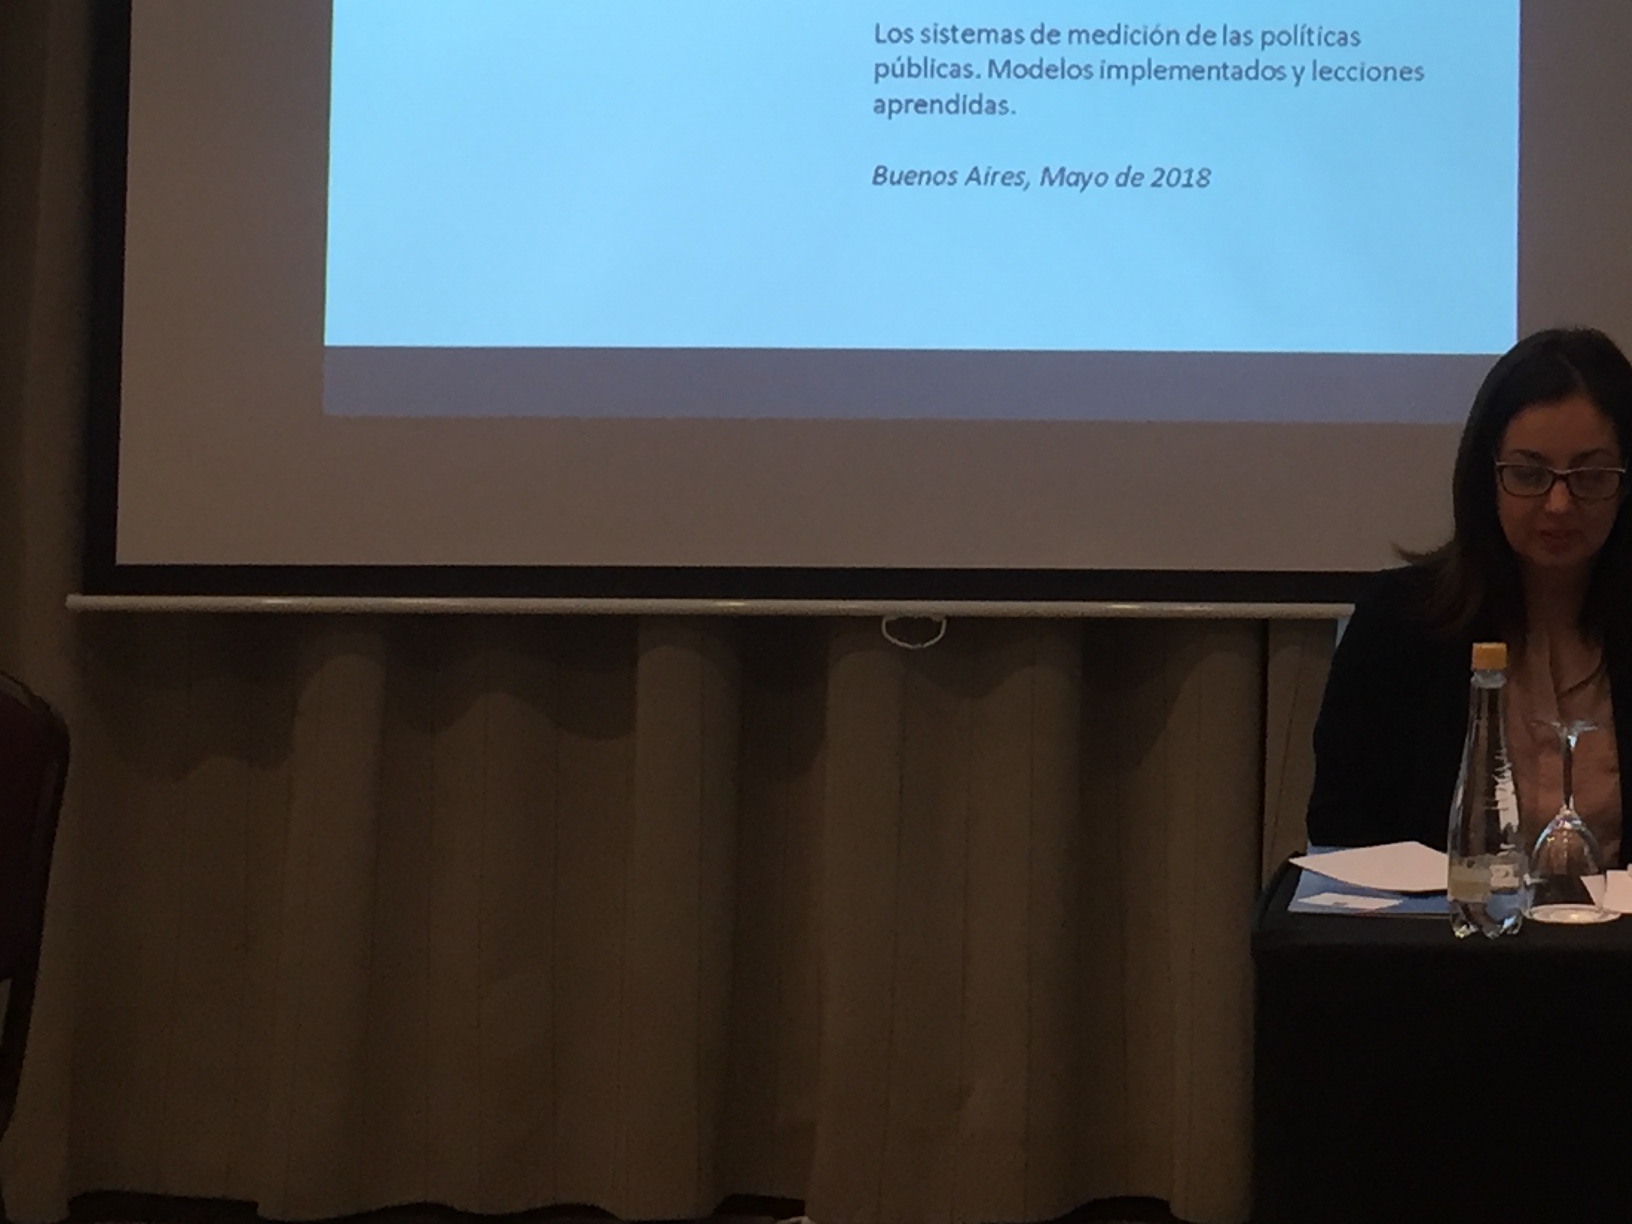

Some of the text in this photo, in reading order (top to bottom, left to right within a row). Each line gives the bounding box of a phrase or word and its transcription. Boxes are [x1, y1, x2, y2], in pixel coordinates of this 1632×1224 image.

[874, 21, 1363, 53] Los sistemas de medición de las políticas
[873, 55, 1426, 88] públicas. Modelos implementados y lecciones
[873, 91, 1017, 121] aprendidas.
[871, 164, 1213, 194] Buenos Aires, Mayo de 2018
